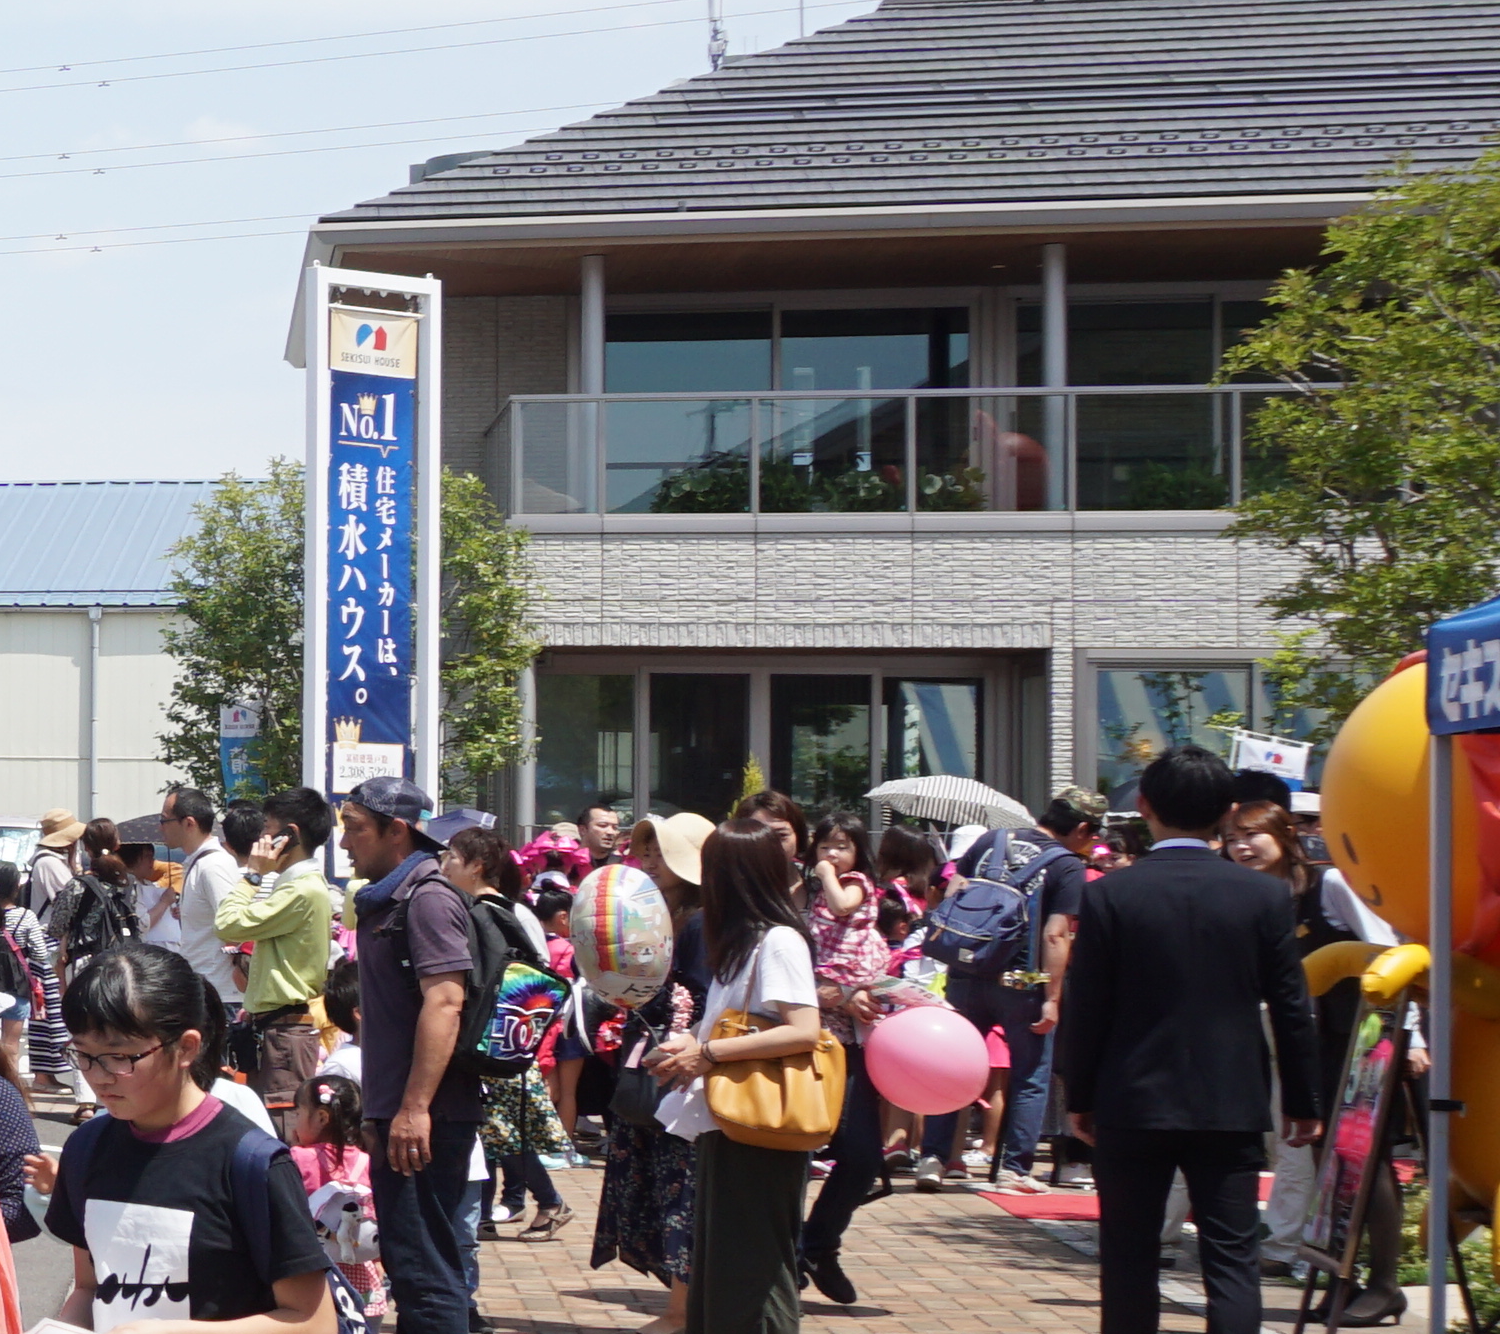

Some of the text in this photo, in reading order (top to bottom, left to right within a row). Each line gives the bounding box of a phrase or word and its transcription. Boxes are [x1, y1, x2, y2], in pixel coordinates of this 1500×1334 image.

[339, 393, 398, 441] No.1
[341, 351, 401, 368] SEKISUI HOUSE
[338, 462, 369, 705] 積水ハウス。
[375, 465, 398, 677] 住宅メーカーは、
